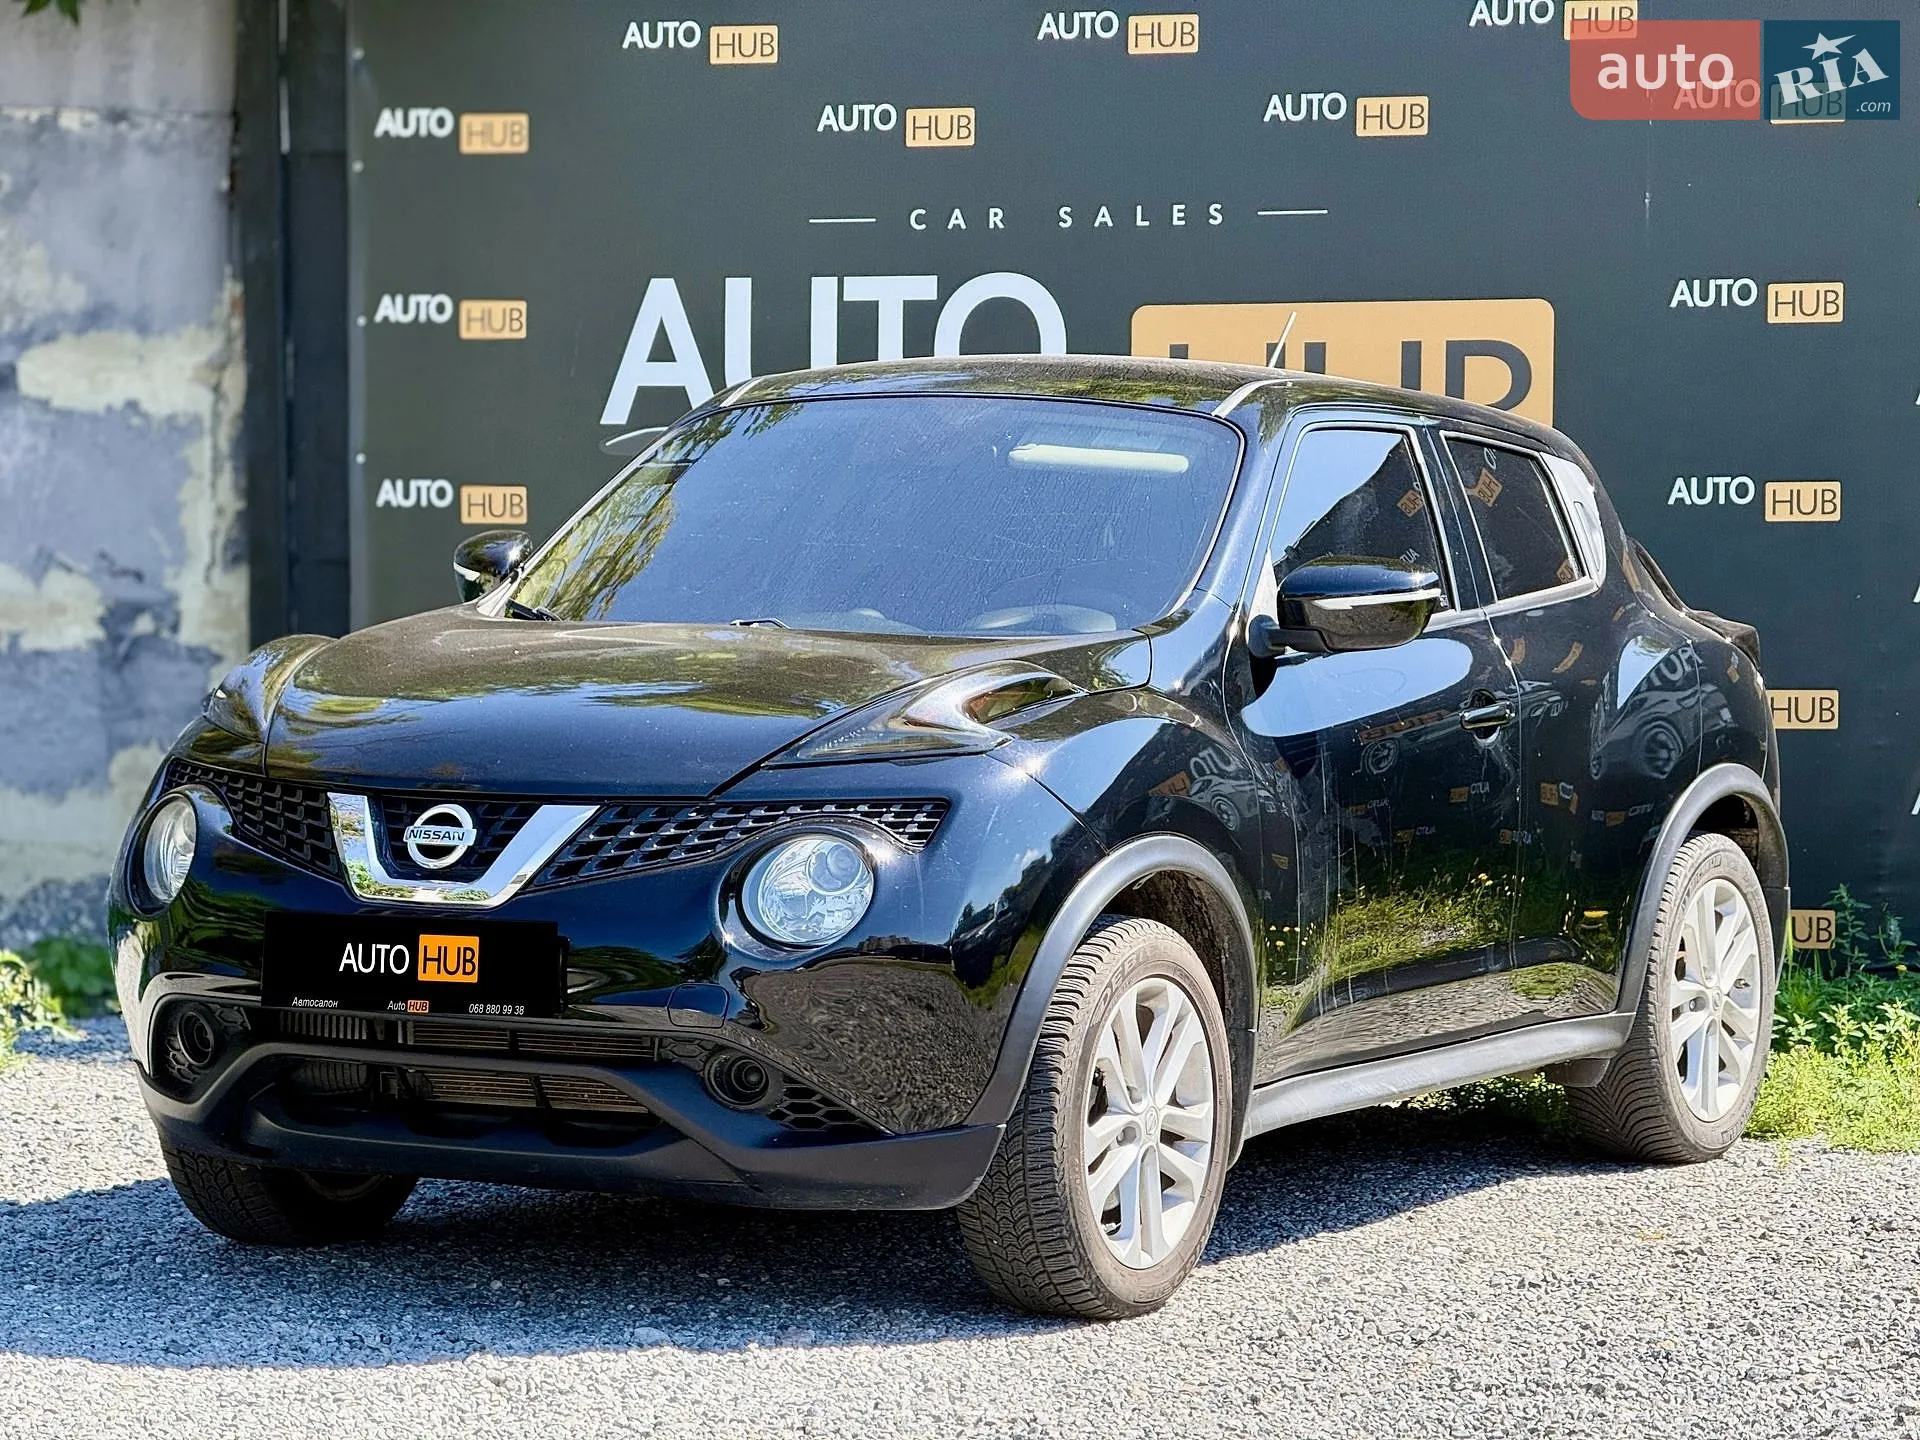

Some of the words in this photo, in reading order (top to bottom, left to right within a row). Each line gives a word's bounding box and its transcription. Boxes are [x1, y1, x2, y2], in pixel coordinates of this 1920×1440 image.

[1037, 11, 1119, 40] AUTO
[1134, 22, 1195, 48] HUB
[1469, 0, 1554, 27] AUTO
[1571, 6, 1634, 34] HUB
[623, 21, 701, 48] AUTO
[715, 32, 774, 58] HUB
[375, 108, 453, 137] AUTO
[465, 119, 524, 148] HUB
[817, 104, 897, 132] AUTO
[912, 114, 971, 141] HUB
[1263, 93, 1347, 122] AUTO
[1363, 104, 1425, 131] HUB
[910, 208, 1004, 230] CAR
[1059, 203, 1223, 228] SALES
[375, 294, 453, 323] AUTO
[465, 307, 524, 333] HUB
[1670, 278, 1757, 308] AUTO
[1775, 289, 1840, 317] HUB
[376, 479, 453, 508] AUTO
[467, 492, 524, 518] HUB
[1668, 476, 1755, 505] AUTO
[1772, 488, 1837, 515] HUB
[1772, 696, 1836, 723] HUB
[408, 829, 465, 842] NISSAN
[1792, 916, 1833, 943] UB
[339, 943, 409, 974] AUTO
[422, 945, 476, 976] HUB
[292, 996, 338, 1008] Автосалон
[387, 1001, 406, 1011] Auto
[408, 1001, 428, 1012] HUB
[468, 1003, 484, 1014] 068
[485, 1004, 500, 1015] 880
[502, 1005, 512, 1015] 99
[514, 1005, 525, 1015] 38
